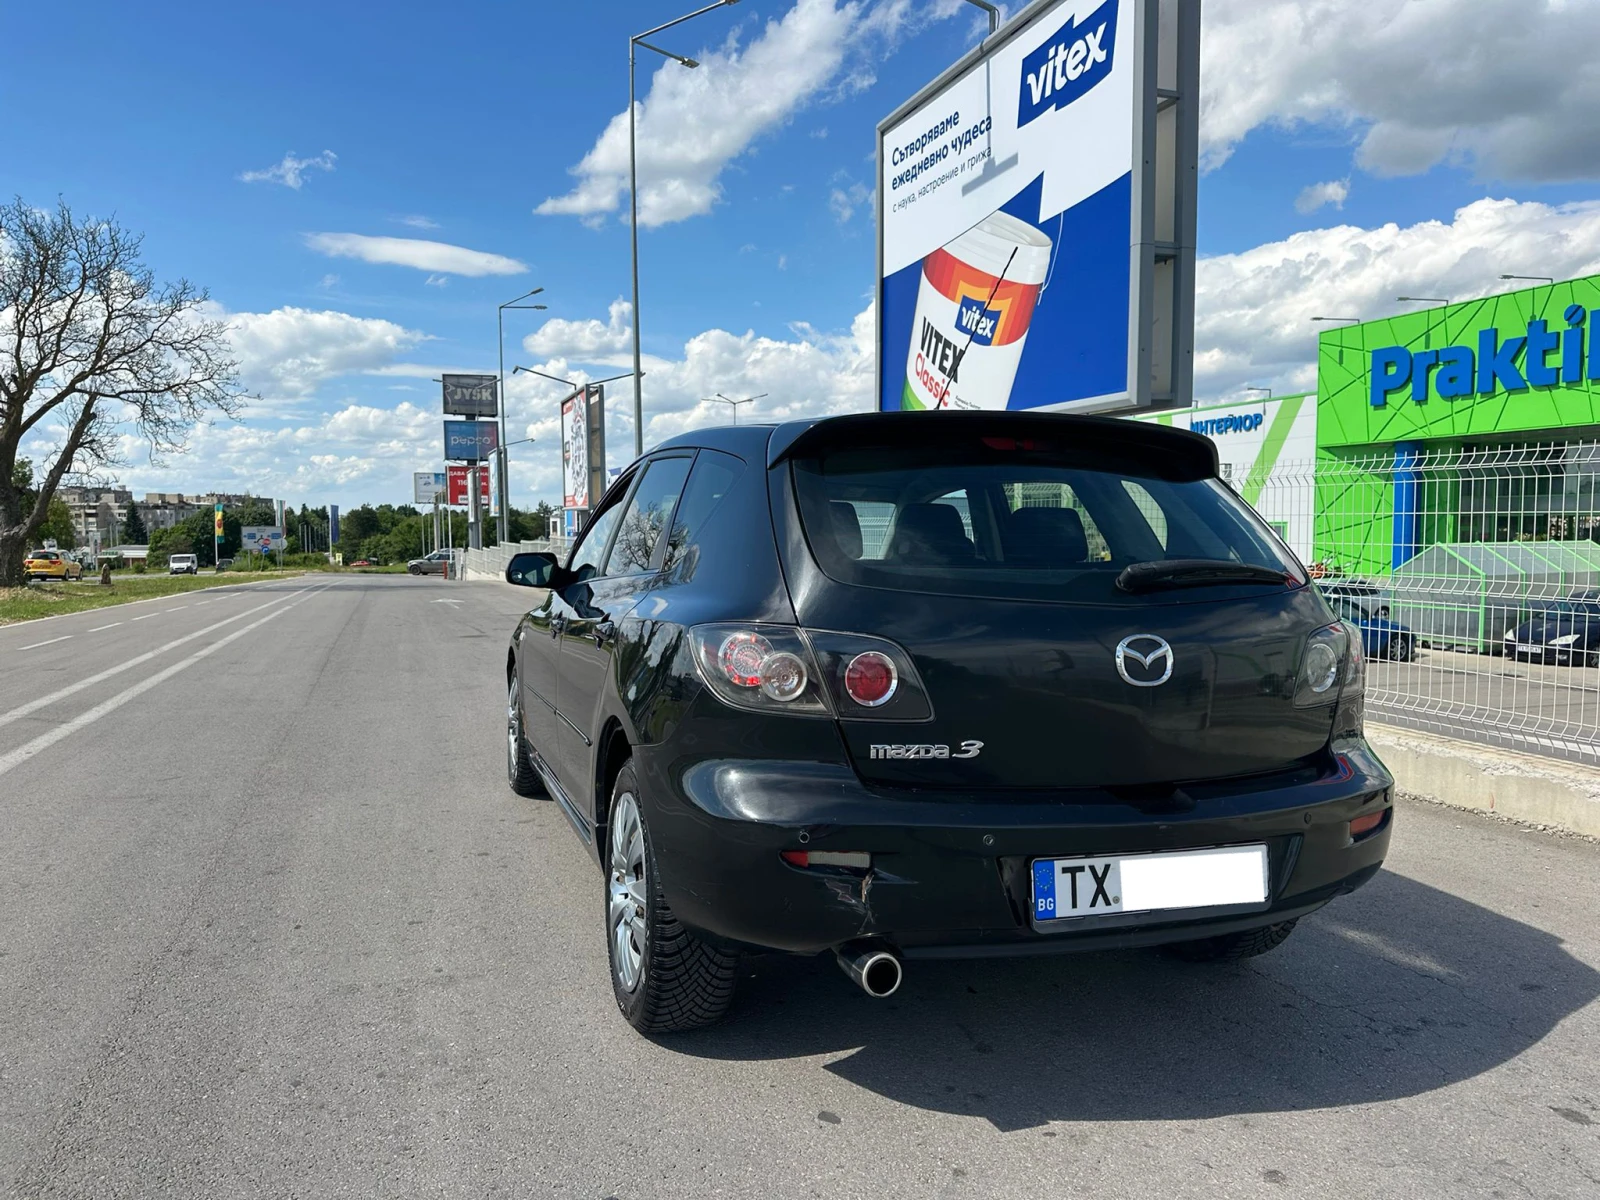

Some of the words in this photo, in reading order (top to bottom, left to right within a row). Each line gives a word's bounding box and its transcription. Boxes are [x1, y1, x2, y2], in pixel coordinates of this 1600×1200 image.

[1027, 22, 1107, 106] vitex
[892, 111, 960, 166] Сътворяваме
[892, 145, 949, 190] ежедневно
[951, 116, 992, 155] чудеса
[892, 202, 897, 213] с
[897, 196, 917, 211] наука,
[918, 166, 959, 199] настроение
[960, 155, 966, 172] и
[967, 146, 992, 170] грижа
[961, 306, 996, 339] vitex
[920, 316, 966, 384] VITEX
[1370, 304, 1600, 410] Prakti
[453, 388, 493, 401] JYSK
[915, 353, 951, 407] Classic
[450, 435, 491, 446] pepco
[1190, 413, 1263, 436] ИНТЕРИОР
[951, 740, 985, 759] 3
[1038, 897, 1054, 911] BG
[1061, 863, 1112, 909] TX
